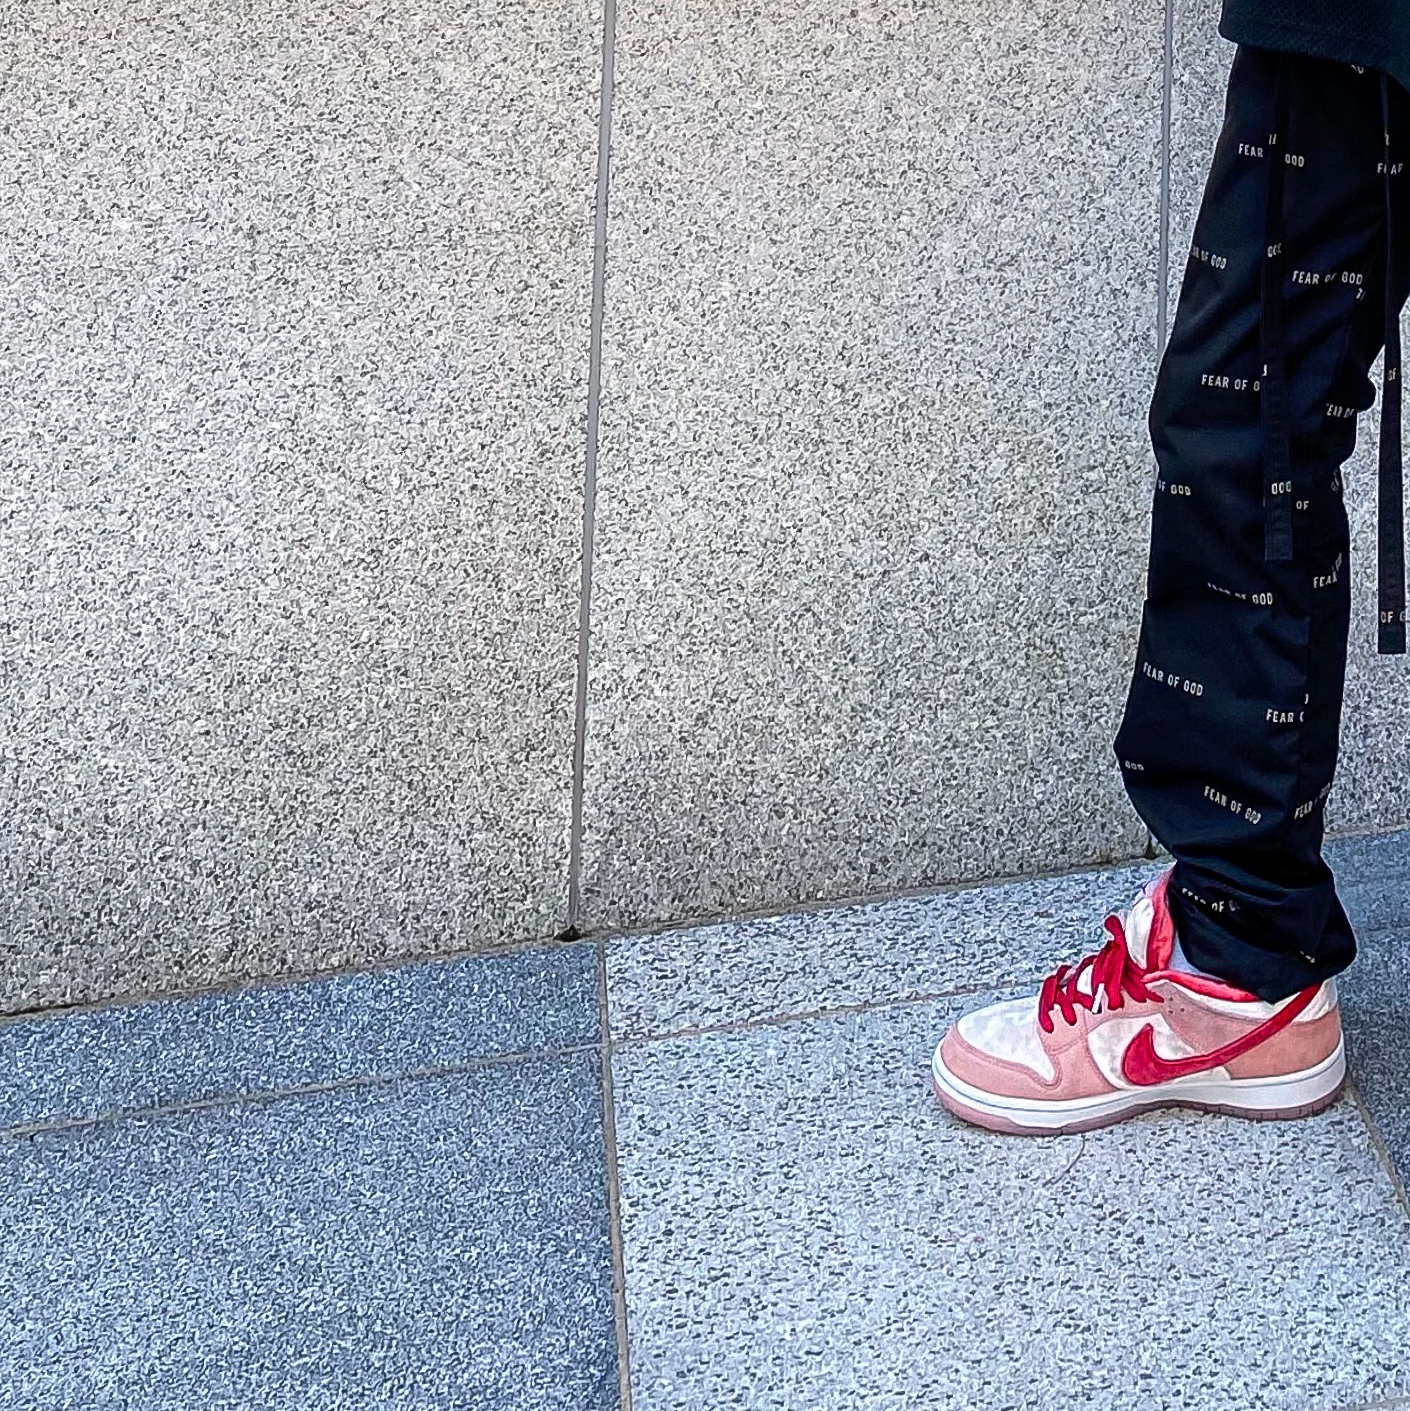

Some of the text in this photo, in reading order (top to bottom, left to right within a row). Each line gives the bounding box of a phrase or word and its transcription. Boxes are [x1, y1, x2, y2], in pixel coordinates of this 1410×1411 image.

[1238, 143, 1305, 168] FEAR GOD
[1211, 254, 1227, 269] GOD
[1292, 270, 1319, 284] FEAR
[1341, 271, 1363, 285] GOD
[1201, 374, 1229, 389] FEAR
[1234, 379, 1248, 390] OF
[1170, 484, 1191, 496] GOD
[1296, 500, 1309, 510] OF
[1252, 592, 1273, 606] GOD
[1380, 611, 1394, 624] OF
[1143, 661, 1204, 697] FEAR OF GOD
[1266, 709, 1294, 723] FEAR
[1204, 785, 1262, 824] FEAR OF GOD
